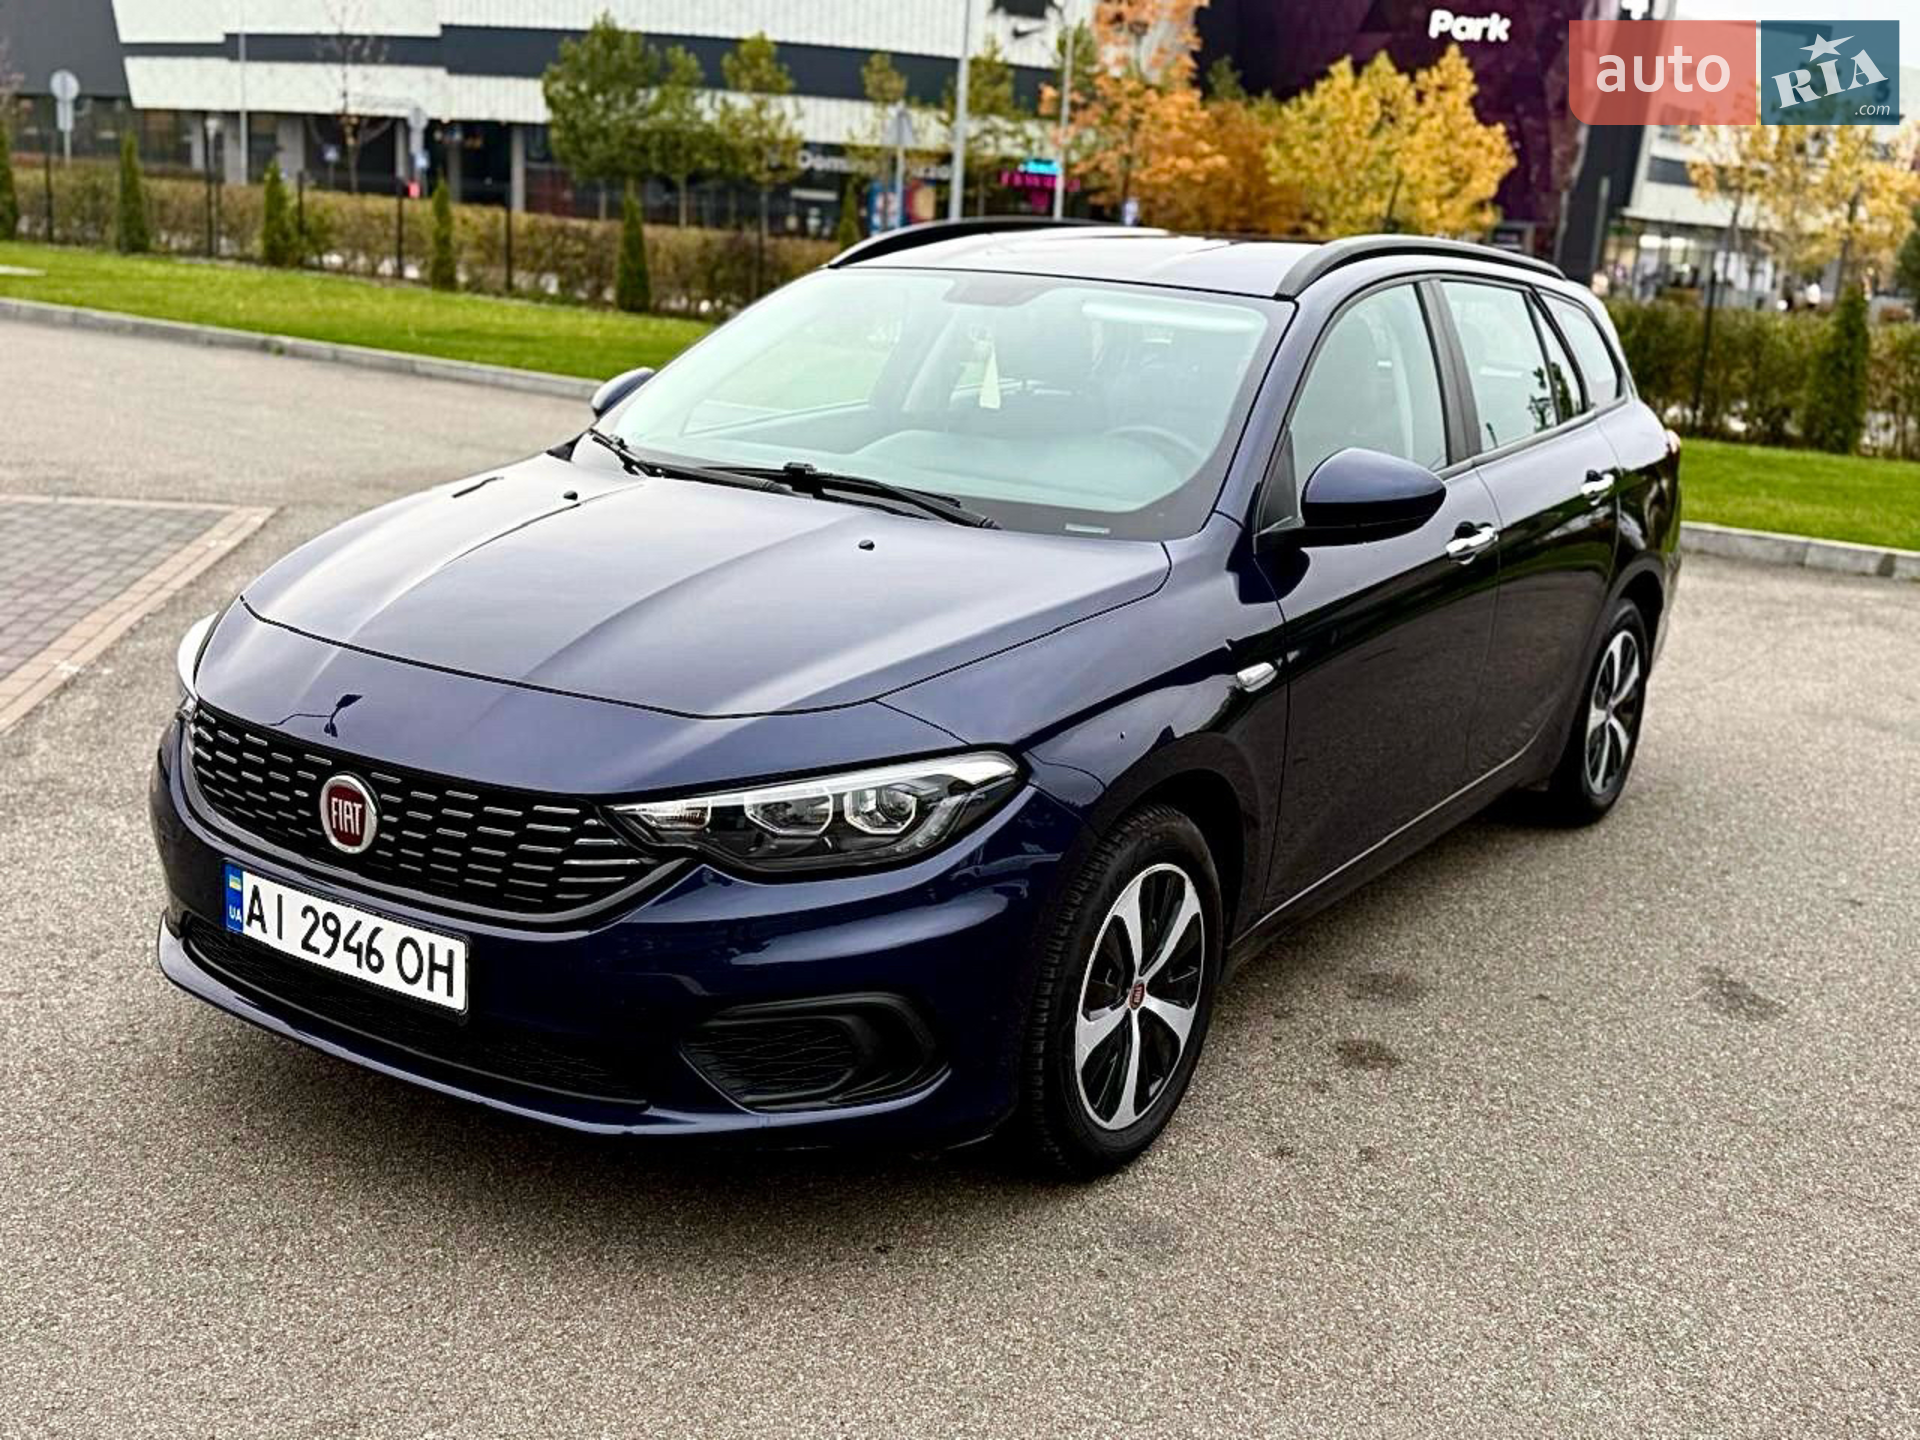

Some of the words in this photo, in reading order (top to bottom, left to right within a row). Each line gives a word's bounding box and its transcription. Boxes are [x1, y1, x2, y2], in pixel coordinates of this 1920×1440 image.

[1428, 9, 1511, 42] Park
[331, 797, 362, 836] FIAT
[229, 905, 242, 923] UA
[246, 885, 283, 940] AI
[301, 905, 385, 974] 2946
[396, 936, 455, 997] OH
